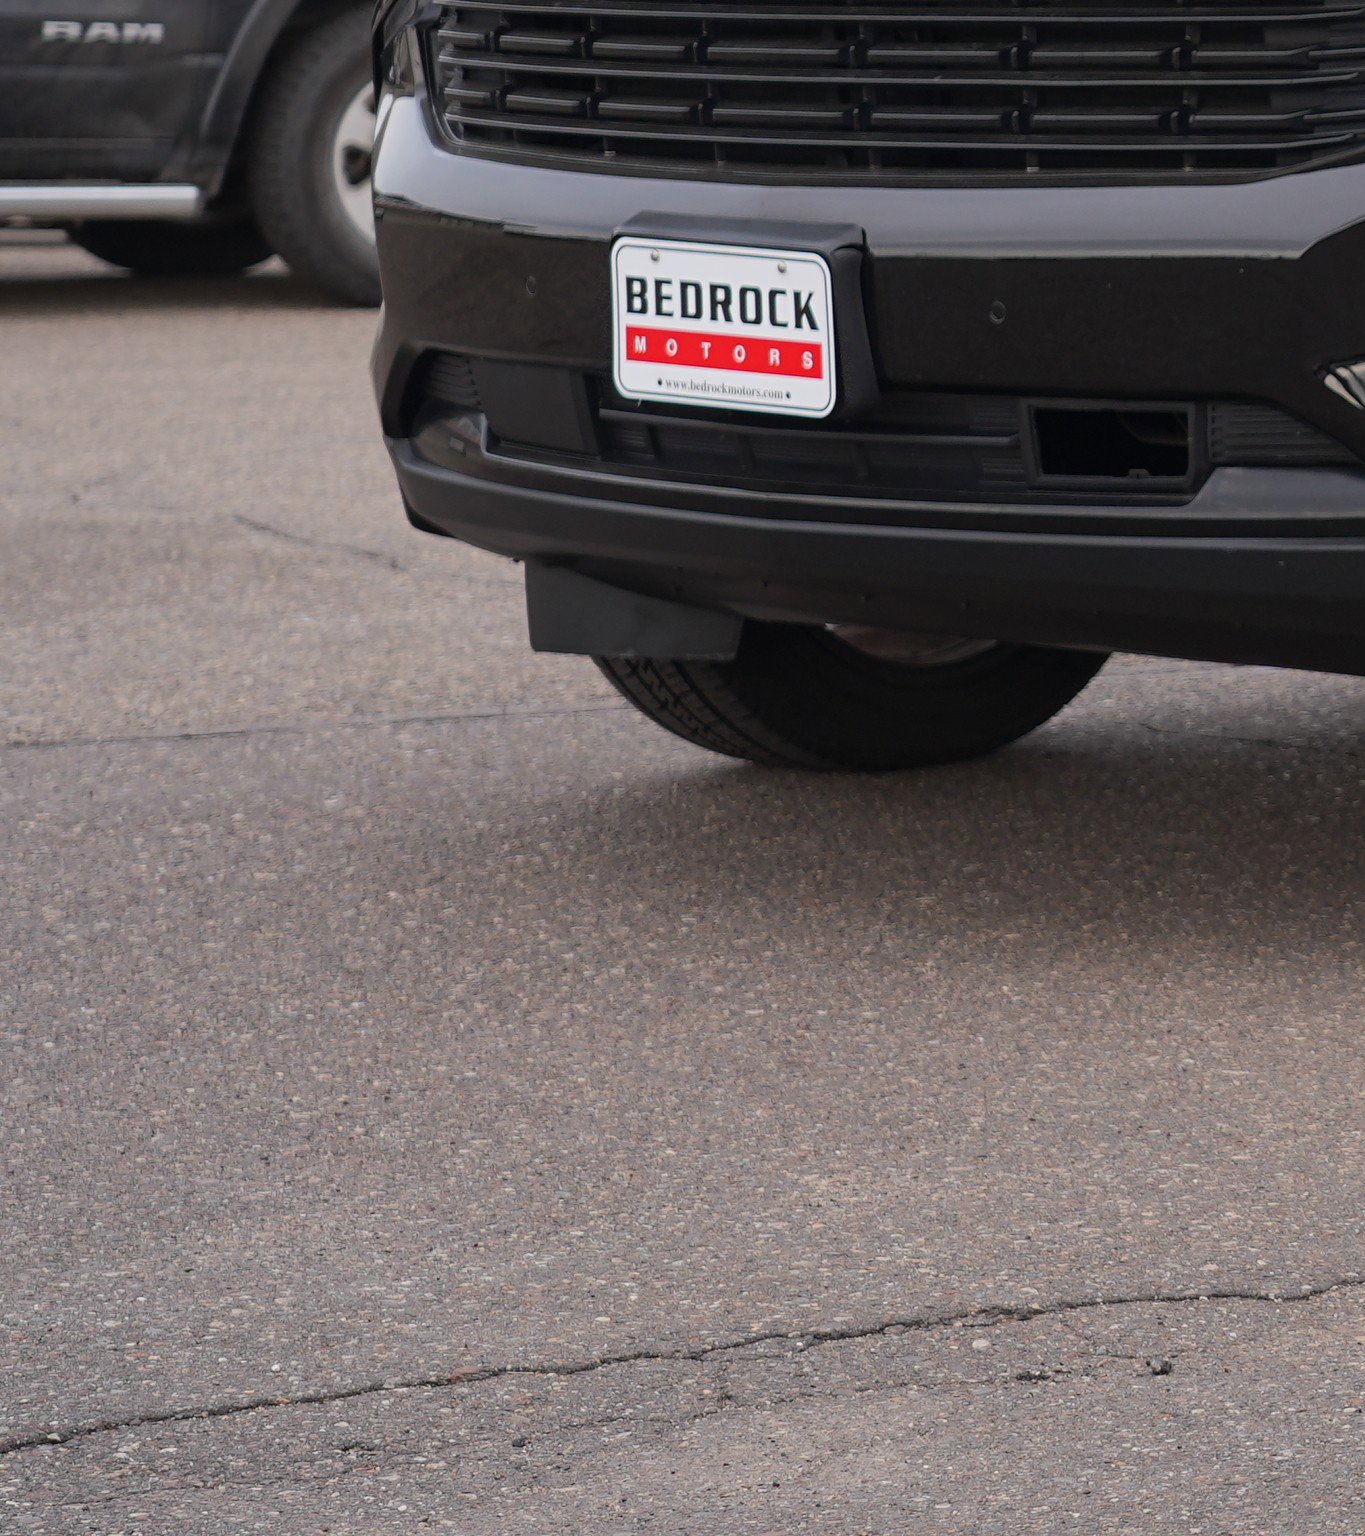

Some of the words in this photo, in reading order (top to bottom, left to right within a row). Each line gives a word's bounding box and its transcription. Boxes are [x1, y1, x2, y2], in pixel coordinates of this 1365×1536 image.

[41, 20, 165, 44] RAM
[625, 276, 820, 330] BEDROCK
[633, 335, 815, 370] MOTORS
[665, 377, 784, 400] www.bedrockmotors.com
